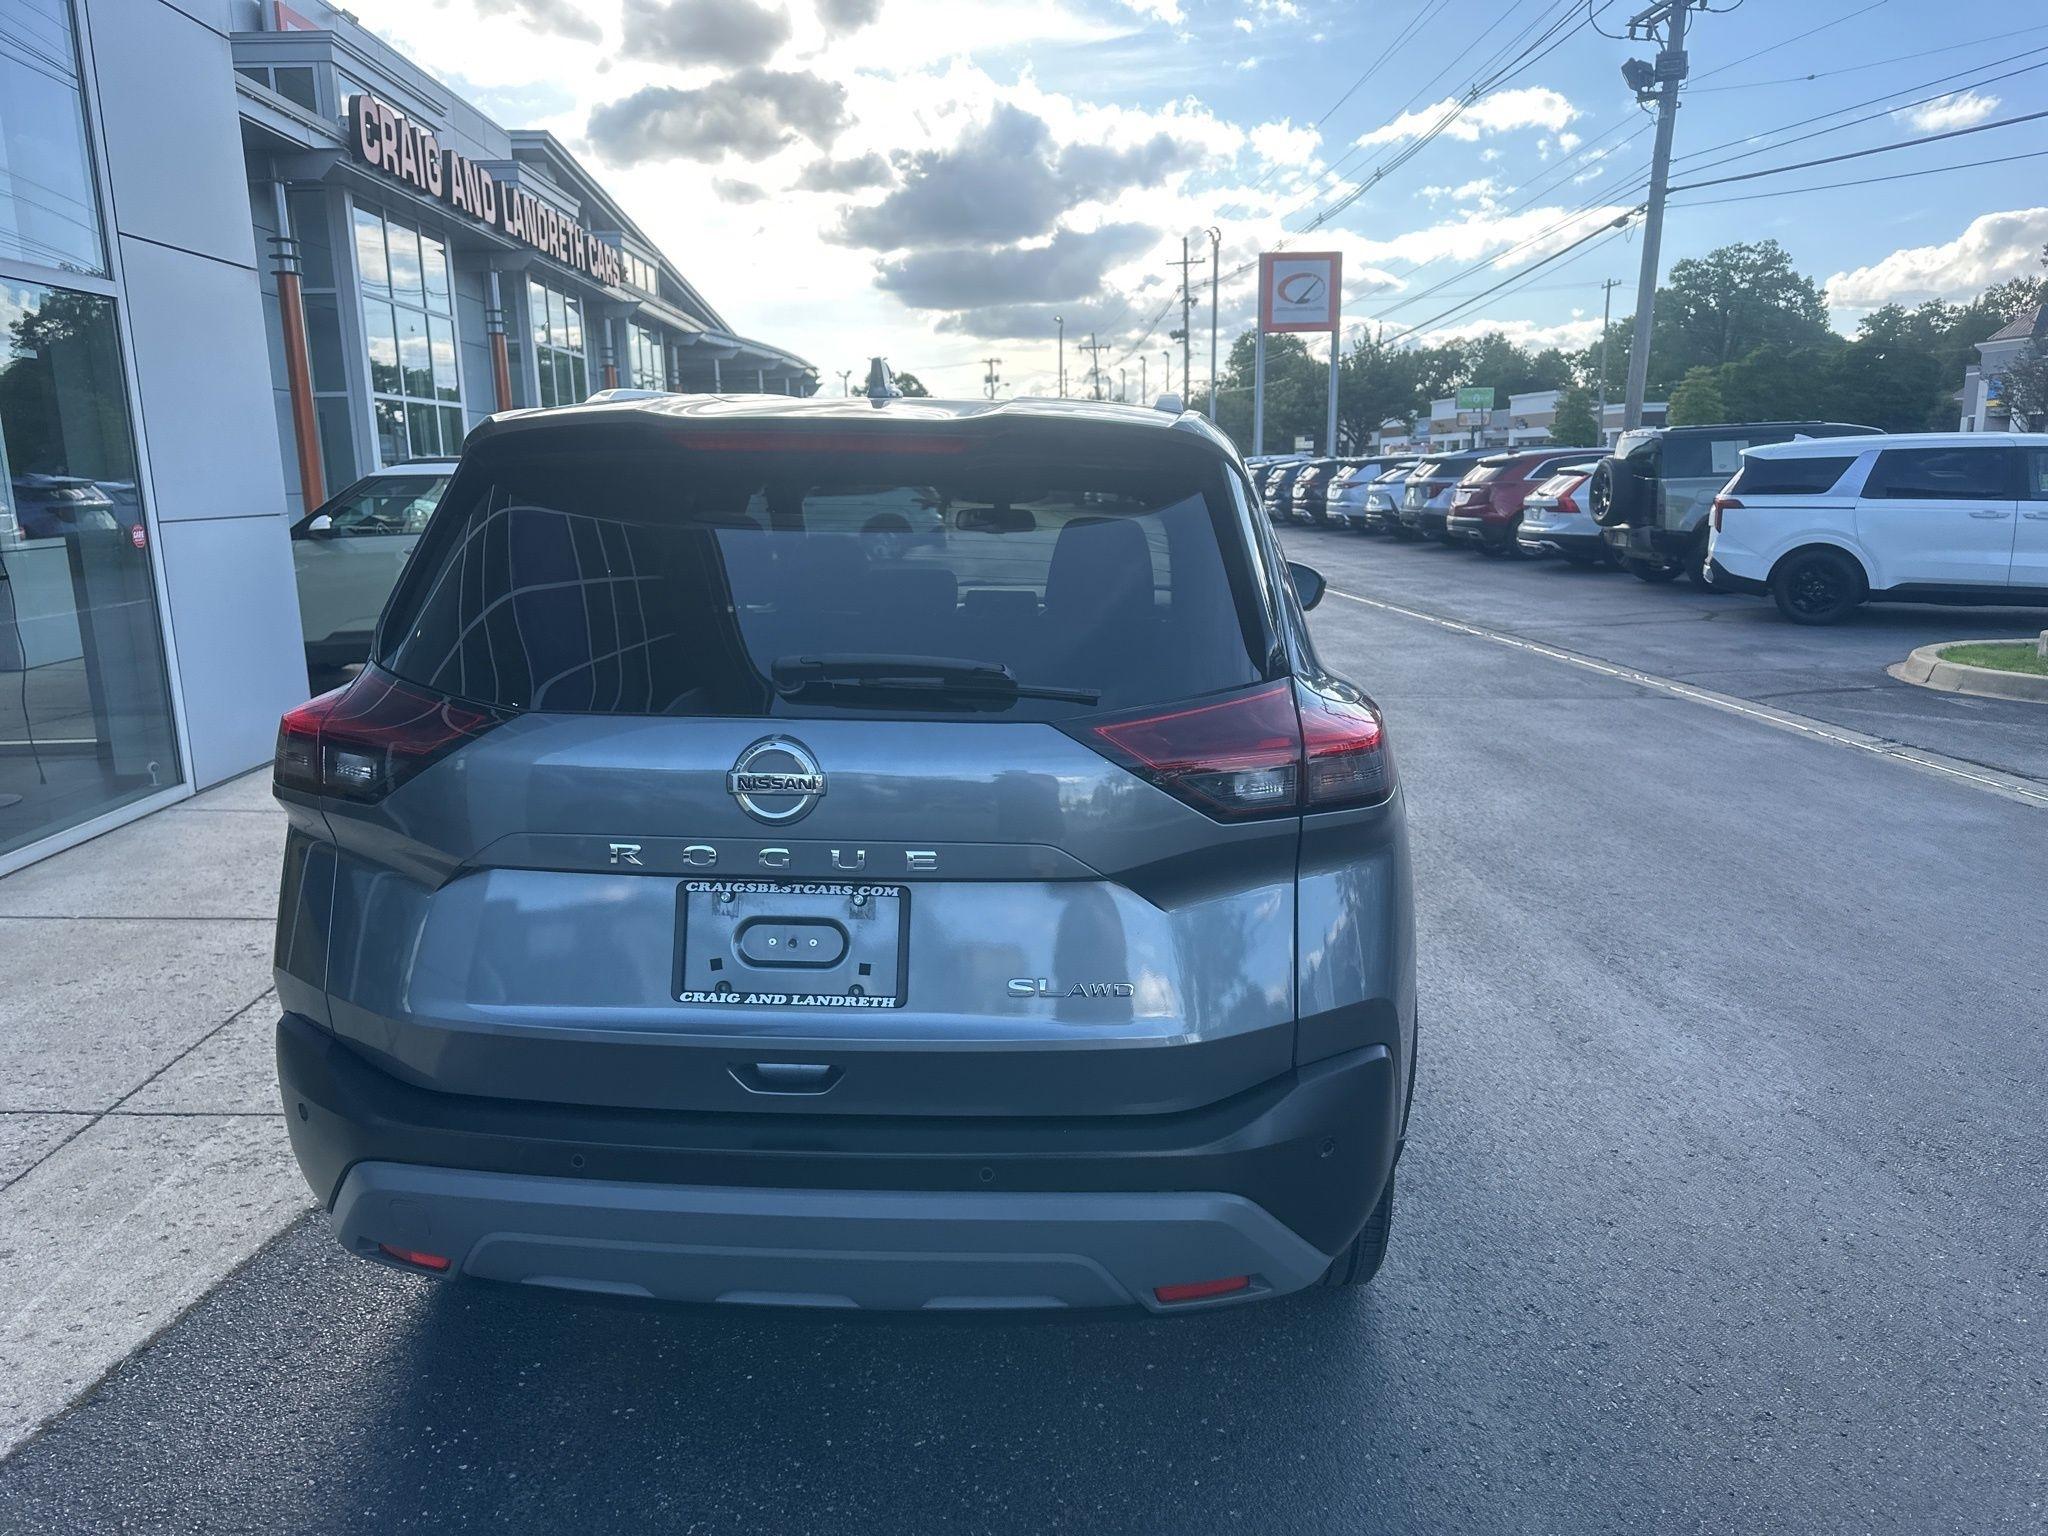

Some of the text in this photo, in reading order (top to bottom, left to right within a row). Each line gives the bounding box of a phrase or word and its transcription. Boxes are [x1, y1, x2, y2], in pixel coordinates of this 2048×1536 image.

[359, 95, 621, 288] CRAIG AND LANDRETH CARS
[737, 775, 817, 791] NISSAN
[609, 843, 938, 872] ROGUE
[685, 882, 900, 897] CRAIGSBESTCARS.COM
[1008, 978, 1135, 998] SL AWD
[679, 992, 896, 1008] CRAIG AND LANDRETH
